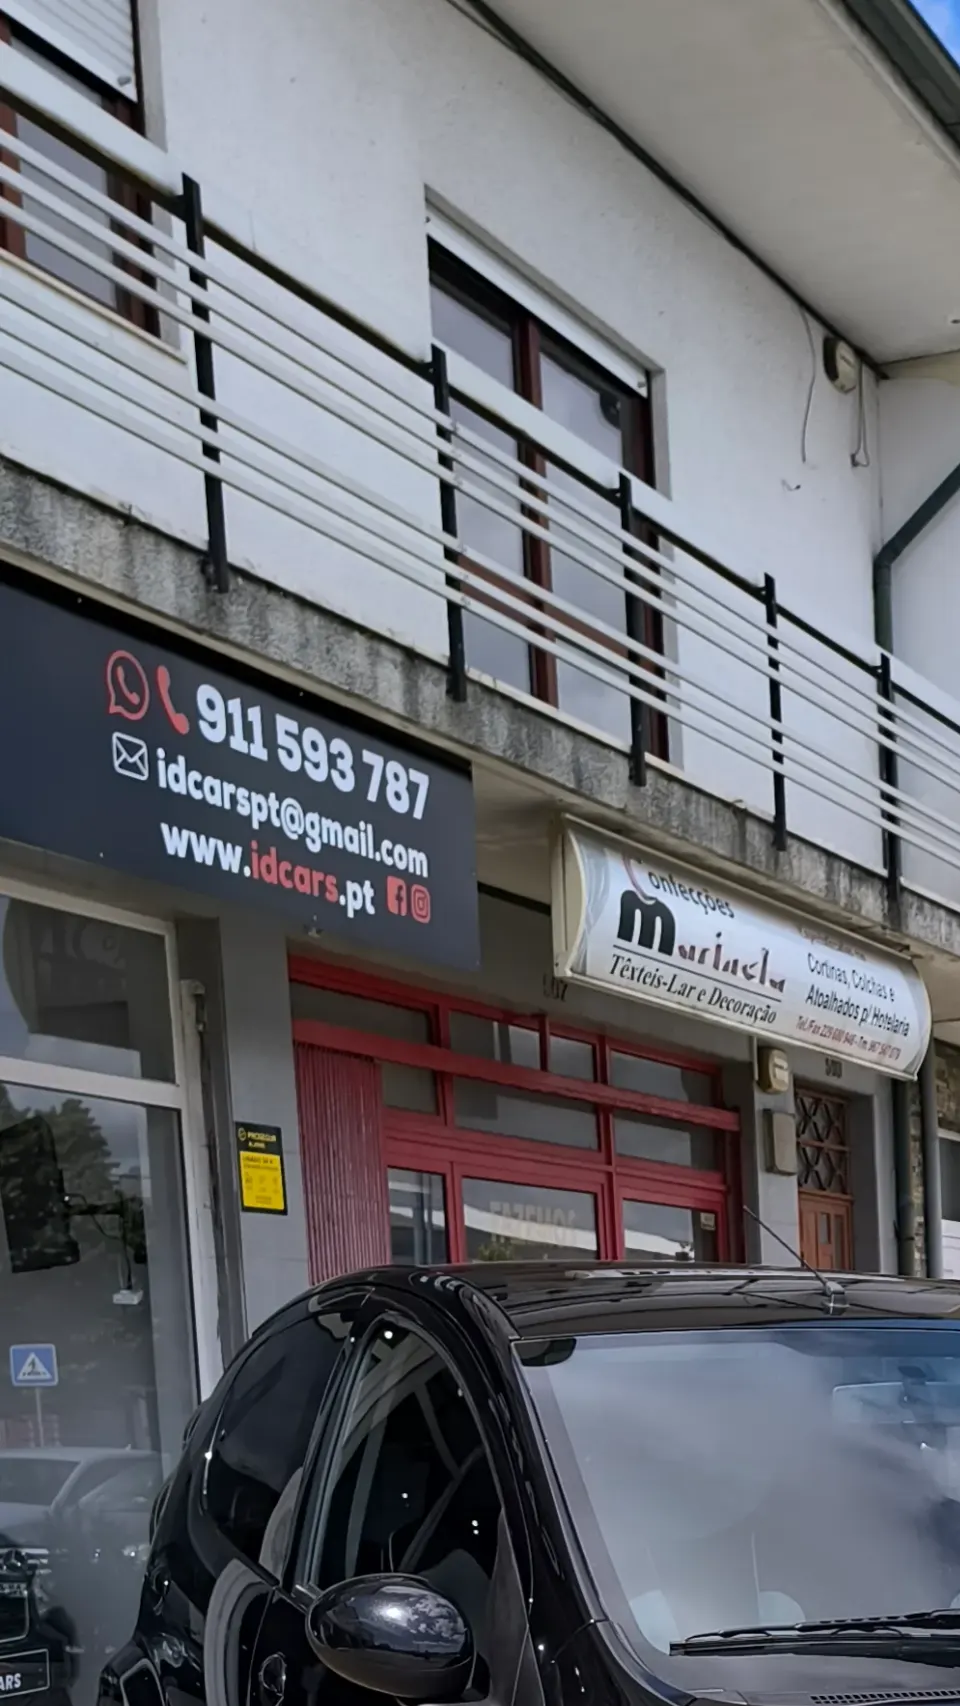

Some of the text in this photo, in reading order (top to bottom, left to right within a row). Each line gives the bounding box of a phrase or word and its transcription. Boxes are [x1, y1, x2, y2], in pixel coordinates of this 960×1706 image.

[196, 684, 430, 820] 911 593 787
[156, 748, 429, 878] idcarspt@gmail.com
[161, 822, 376, 918] www.idcars.pt
[609, 953, 778, 1024] Têxteis-Lar e Decoração
[805, 984, 859, 1020] Atoalhados
[872, 1005, 909, 1037] Hotelaria
